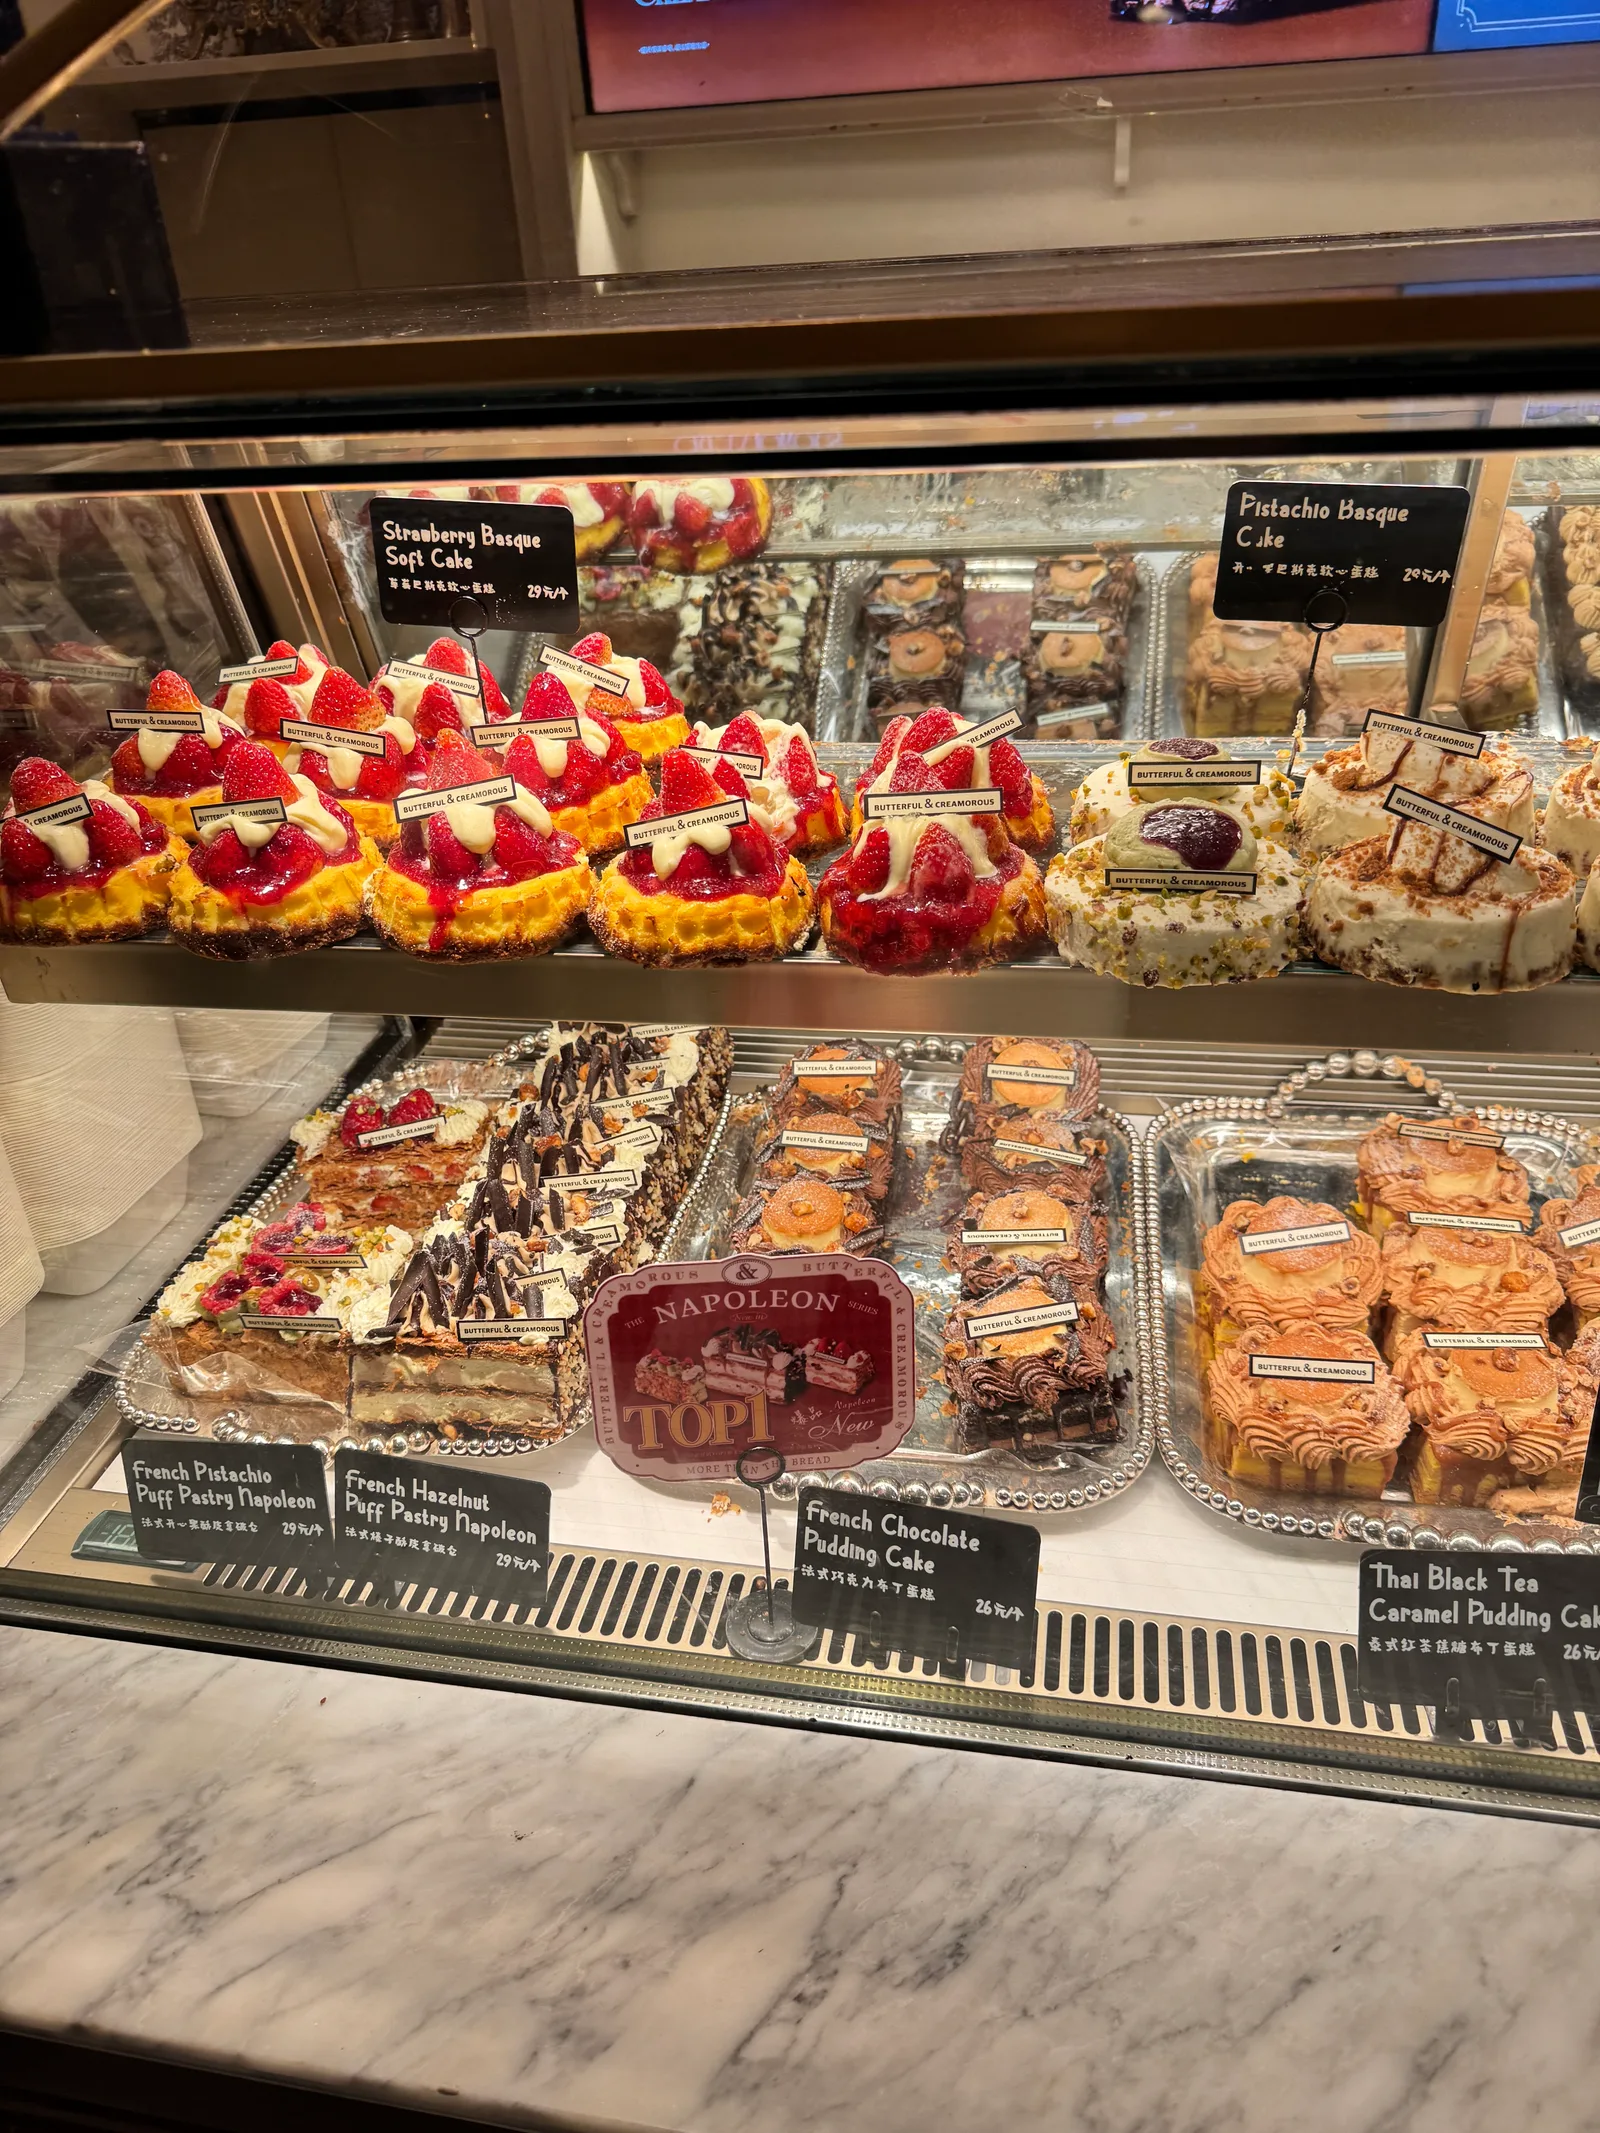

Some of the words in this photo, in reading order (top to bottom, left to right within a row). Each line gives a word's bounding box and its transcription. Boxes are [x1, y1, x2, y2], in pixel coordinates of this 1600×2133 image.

[1239, 492, 1330, 519] Pistachio
[1337, 499, 1409, 528] Basque
[382, 520, 475, 549] Strawberry
[481, 523, 541, 554] Basque
[385, 546, 424, 573] Soft
[430, 548, 473, 569] Cake
[388, 577, 496, 594] 草莓巴斯克软心蛋糕
[527, 584, 569, 600] 29元/个
[223, 668, 251, 678] BUTTERFUL
[252, 666, 257, 675] &
[258, 663, 293, 674] CREAMOROUS
[393, 667, 428, 679] BUTTERFUL
[427, 672, 434, 681] &
[434, 676, 476, 691] CREAMOROUS
[545, 653, 577, 671] BUTTERFUL
[576, 664, 583, 673] &
[583, 669, 621, 690] CREAMOROUS
[114, 717, 149, 726] BUTTERFUL
[149, 716, 156, 725] &
[156, 718, 198, 727] CREAMOROUS
[967, 717, 1015, 744] REAMOROUS
[287, 727, 325, 740] BUTTERFUL
[325, 731, 333, 741] &
[333, 736, 379, 750] CREAMOROUS
[1372, 720, 1413, 736] BUTTERFUL
[1414, 727, 1422, 737] &
[1423, 732, 1475, 750] CREAMOROUS
[1137, 771, 1184, 779] BUTTERFUL
[1184, 767, 1194, 778] &
[1195, 770, 1252, 778] CREAMOROUS
[403, 799, 446, 813] BUTTERFUL
[446, 793, 455, 804] &
[456, 785, 508, 802] CREAMOROUS
[874, 802, 923, 812] BUTTERFUL
[924, 798, 933, 809] &
[935, 798, 995, 809] CREAMOROUS
[34, 804, 84, 826] CREAMOROUS
[633, 825, 677, 840] BUTTERFUL
[677, 819, 686, 830] &
[687, 810, 740, 828] CREAMOROUS
[1395, 797, 1441, 822] BUTTERFUL
[1441, 813, 1451, 826] &
[1451, 820, 1509, 851] CREAMOROUS
[1115, 877, 1168, 885] BUTTERFUL
[1169, 875, 1180, 885] &
[1181, 879, 1247, 888] CREAMOROUS
[991, 1069, 1023, 1077] BUTTERFUL
[403, 1123, 439, 1135] CREAMORO
[1405, 1128, 1442, 1137] BUTTERFUL
[785, 1135, 817, 1144] BUTTERFUL
[824, 1139, 863, 1148] CREAMOROUS
[582, 1177, 589, 1186] &
[589, 1175, 631, 1185] CREAMOROUS
[1415, 1216, 1456, 1224] BUTTERFUL
[1465, 1220, 1515, 1228] CREAMOROUS
[1568, 1227, 1600, 1241] BUTTERF
[1248, 1237, 1287, 1248] BUTTERFUL
[1287, 1233, 1296, 1242] &
[1296, 1229, 1343, 1241] CREAMOROUS
[736, 1262, 759, 1280] &
[592, 1270, 699, 1328] CREAMOROUS
[624, 1316, 645, 1329] THE
[652, 1289, 840, 1324] NAPOLEON
[847, 1300, 879, 1315] SERIES
[504, 1324, 511, 1333] &
[973, 1321, 1014, 1332] BUTTERFUL
[1014, 1315, 1022, 1325] &
[1023, 1309, 1072, 1323] CREAMOROUS
[803, 1261, 904, 1300] BUTTERFUL
[895, 1323, 908, 1429] CREAMOROUS
[1257, 1363, 1302, 1372] BUTTERFUL
[1303, 1363, 1312, 1373] &
[1312, 1367, 1367, 1376] CREAMOROUS
[596, 1352, 615, 1445] BUTTERFUL
[623, 1389, 775, 1450] TOP1
[808, 1412, 875, 1440] New
[132, 1460, 190, 1481] French
[194, 1460, 272, 1484] Pistachio
[686, 1464, 720, 1475] MORE
[792, 1455, 831, 1466] BREAD
[135, 1482, 174, 1511] Puff
[178, 1483, 234, 1511] Pastry
[238, 1486, 317, 1513] Napoleon
[345, 1469, 406, 1498] French
[412, 1478, 490, 1512] Hazelnut
[141, 1517, 259, 1533] 法式开心果酥皮拿破仑
[282, 1521, 325, 1537] 29元/个
[345, 1490, 386, 1524] Puff
[391, 1499, 449, 1533] Pastry
[455, 1510, 537, 1545] Napoleon
[806, 1499, 873, 1532] French
[881, 1513, 980, 1552] Chocolate
[345, 1526, 458, 1557] 法式榛子酥皮拿破仑
[496, 1552, 541, 1573] 29元/个
[804, 1526, 877, 1568] Pudding
[885, 1545, 936, 1575] Cake
[1368, 1561, 1419, 1590] Thai
[1428, 1563, 1489, 1592] Black
[1497, 1566, 1539, 1593] Tea
[801, 1563, 936, 1601] 法式巧克力布丁蛋糕
[975, 1598, 1025, 1622] 26元/个
[1368, 1597, 1459, 1625] Caramel
[1468, 1598, 1551, 1633] Pudding
[1368, 1636, 1536, 1657] 泰式红茶焦糖布丁蛋糕
